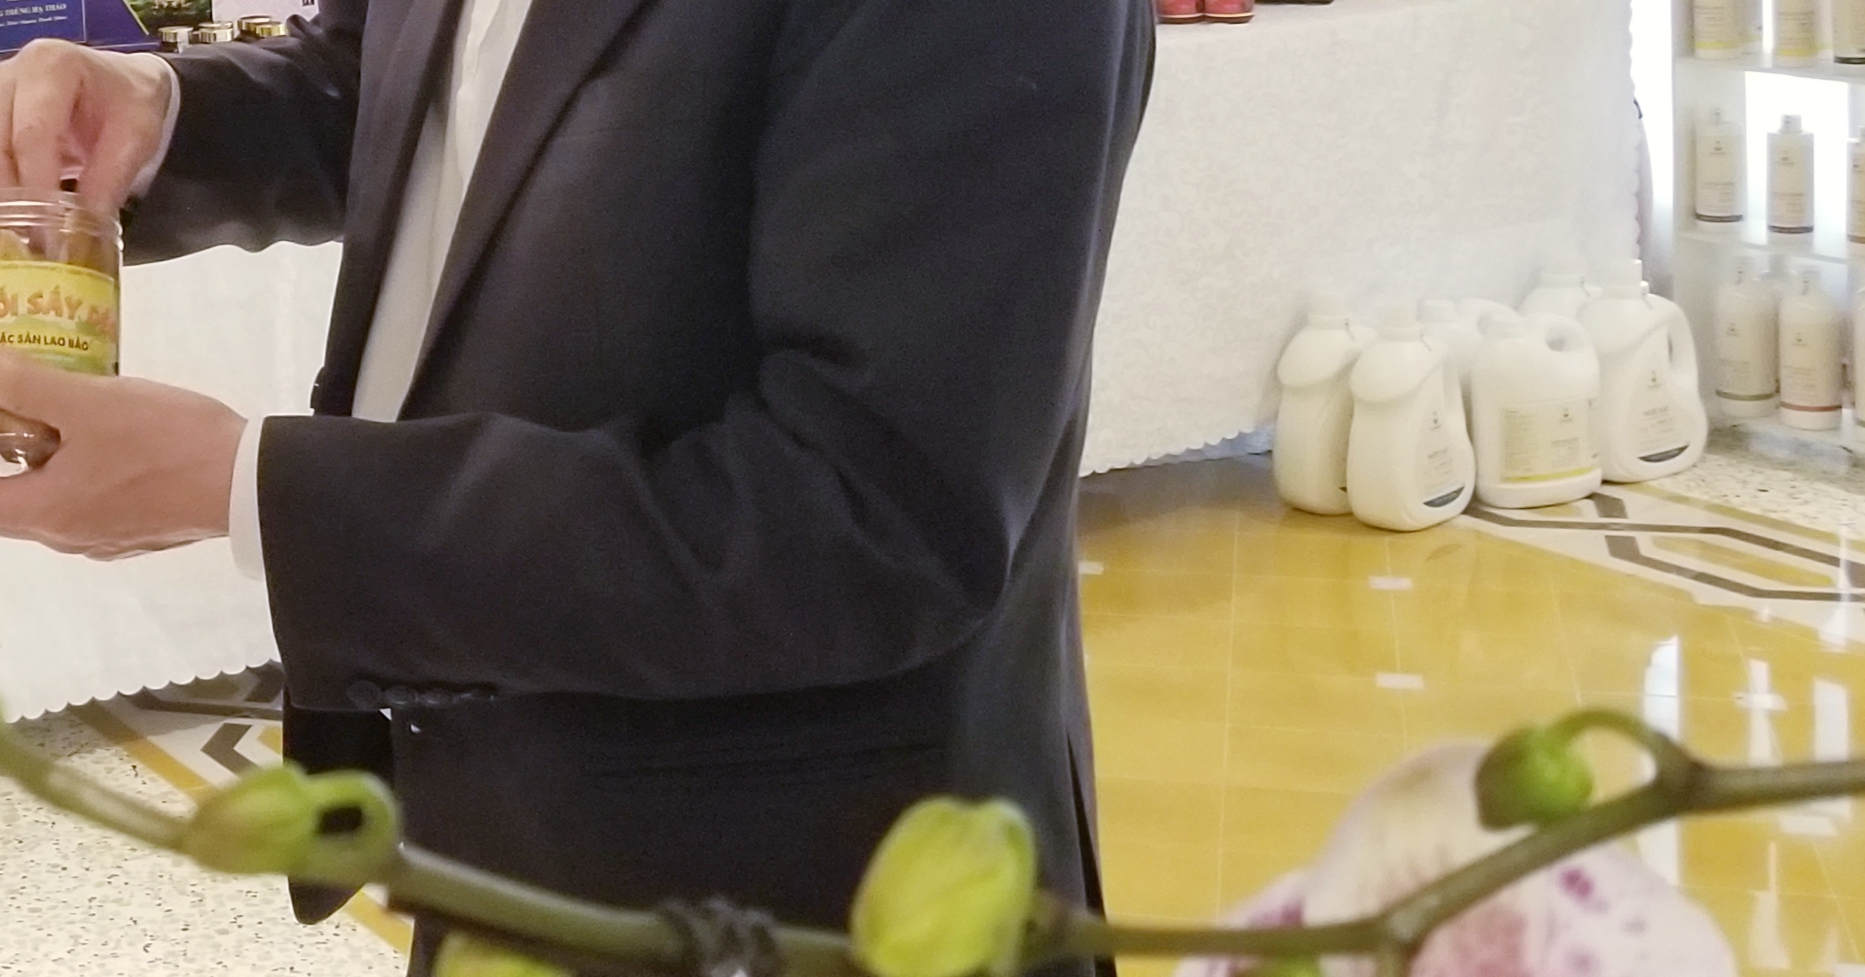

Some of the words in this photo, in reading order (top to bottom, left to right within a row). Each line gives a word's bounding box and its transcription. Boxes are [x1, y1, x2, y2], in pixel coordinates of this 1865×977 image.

[26, 284, 83, 321] SẤY
[17, 331, 41, 344] SẢN
[44, 335, 66, 347] LAO
